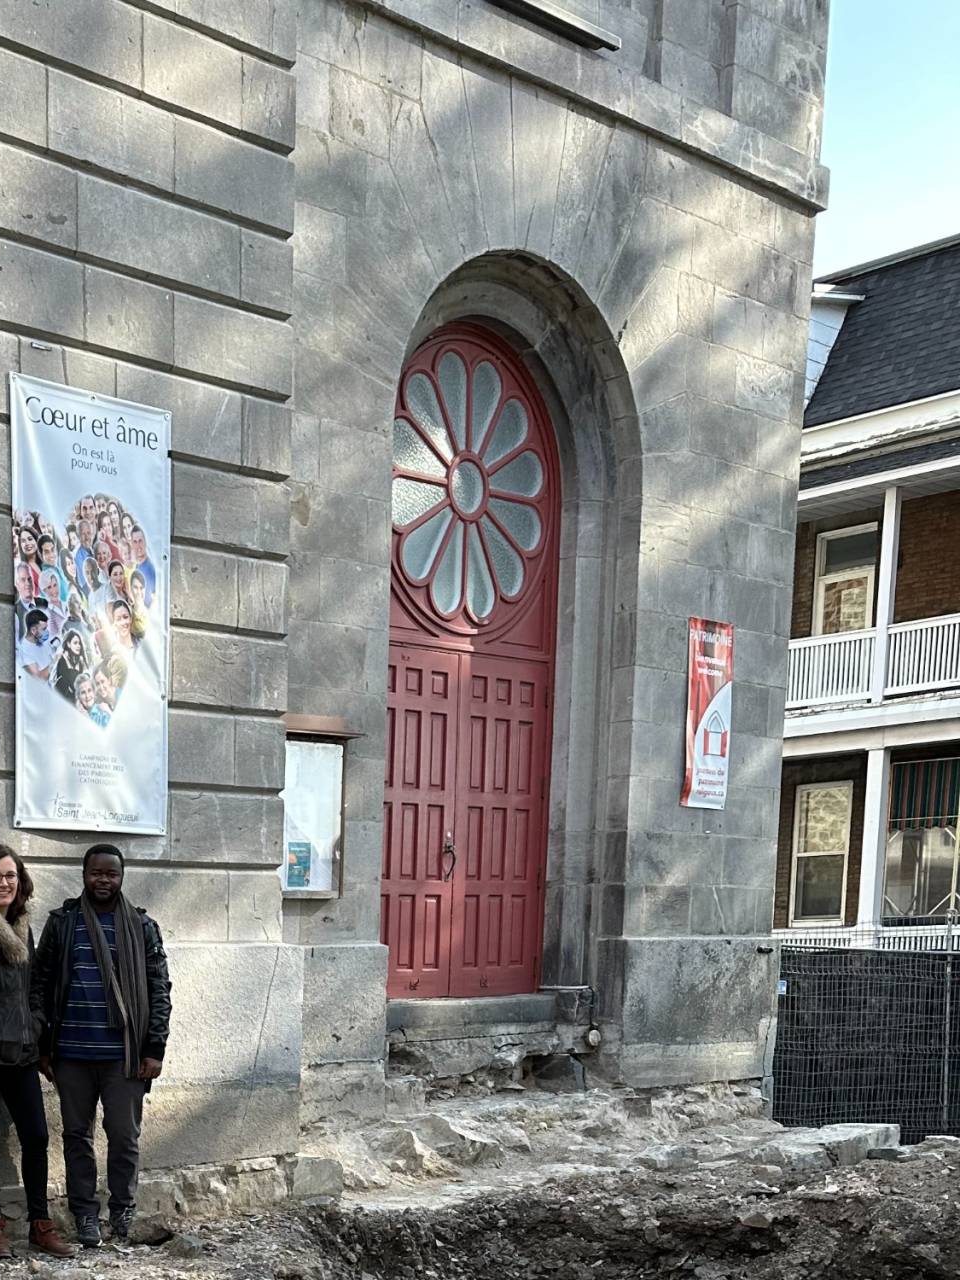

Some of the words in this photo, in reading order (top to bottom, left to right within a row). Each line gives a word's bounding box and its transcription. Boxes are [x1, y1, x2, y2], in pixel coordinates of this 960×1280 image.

[26, 396, 86, 433] Cœur
[91, 417, 110, 440] et
[116, 417, 158, 451] âme
[72, 442, 88, 456] On
[90, 450, 104, 461] est
[107, 449, 116, 463] là
[71, 457, 93, 470] pour
[96, 463, 117, 476] vous
